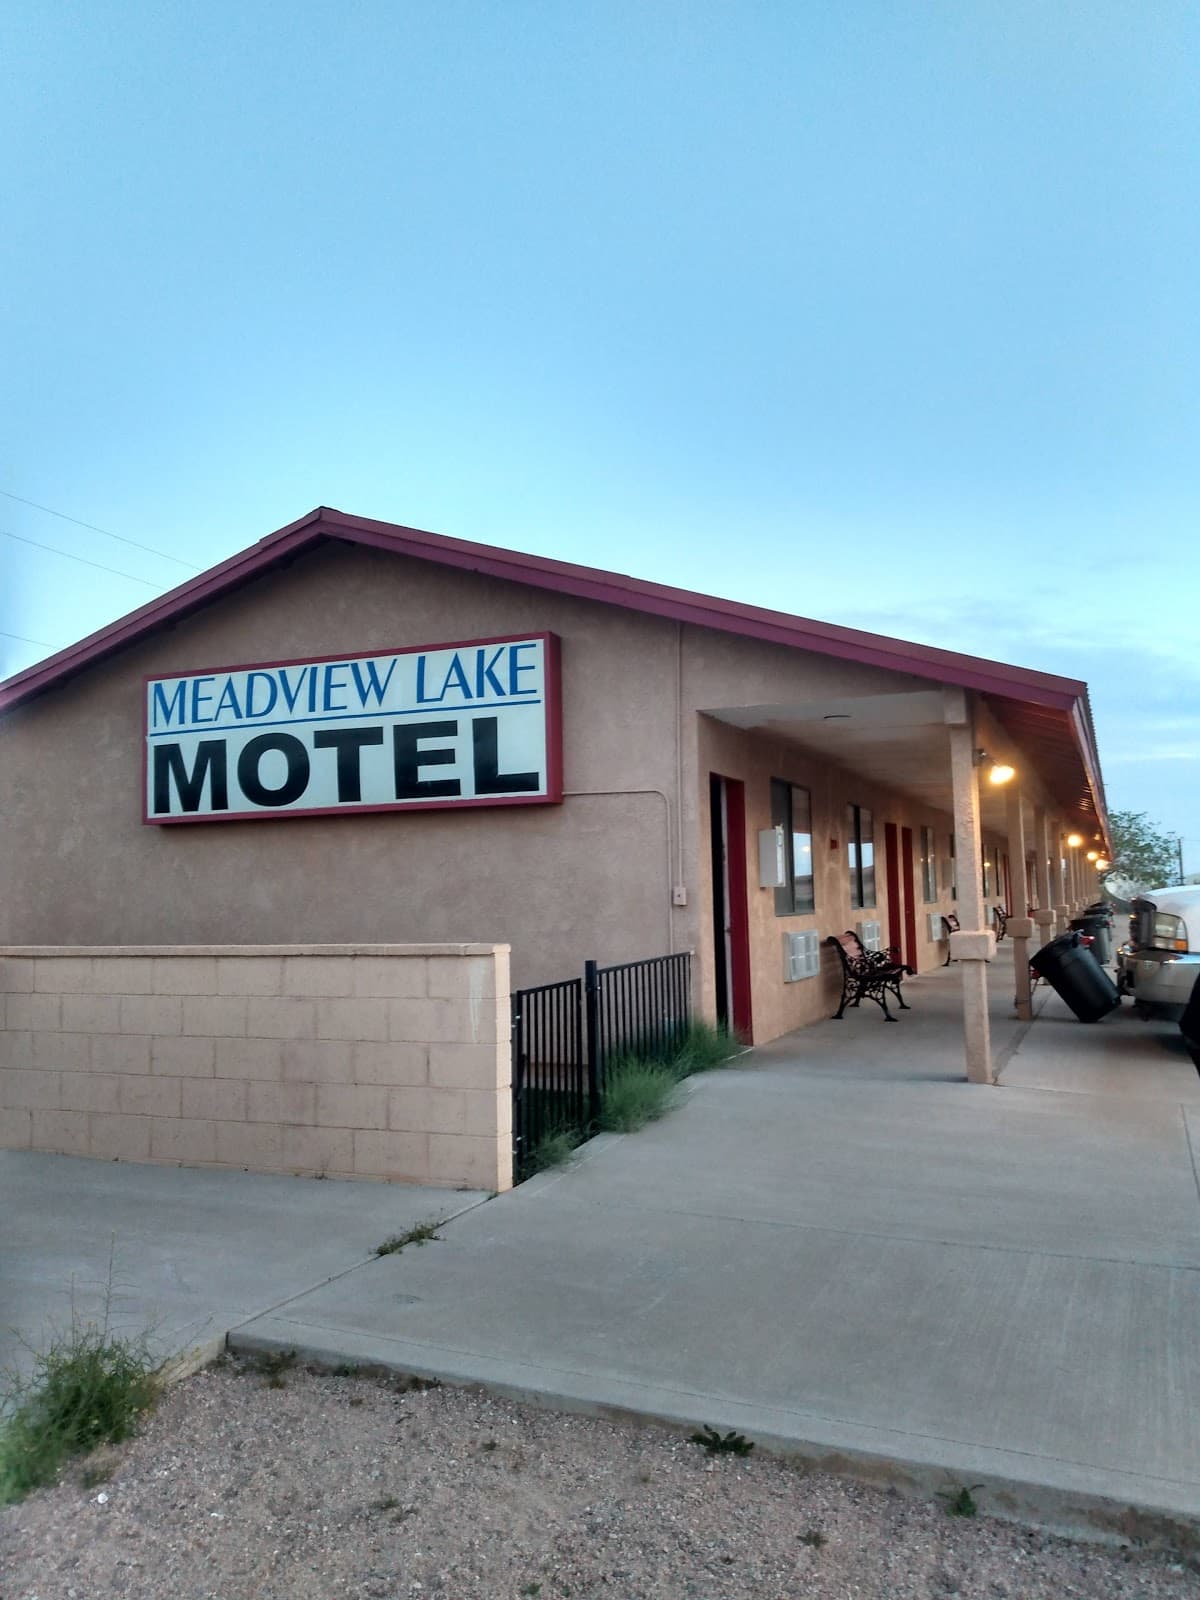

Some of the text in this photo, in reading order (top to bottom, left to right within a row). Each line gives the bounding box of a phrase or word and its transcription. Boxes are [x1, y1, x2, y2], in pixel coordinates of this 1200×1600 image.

[152, 643, 538, 728] MEADVIEW LAKE
[153, 716, 540, 814] MOTEL
